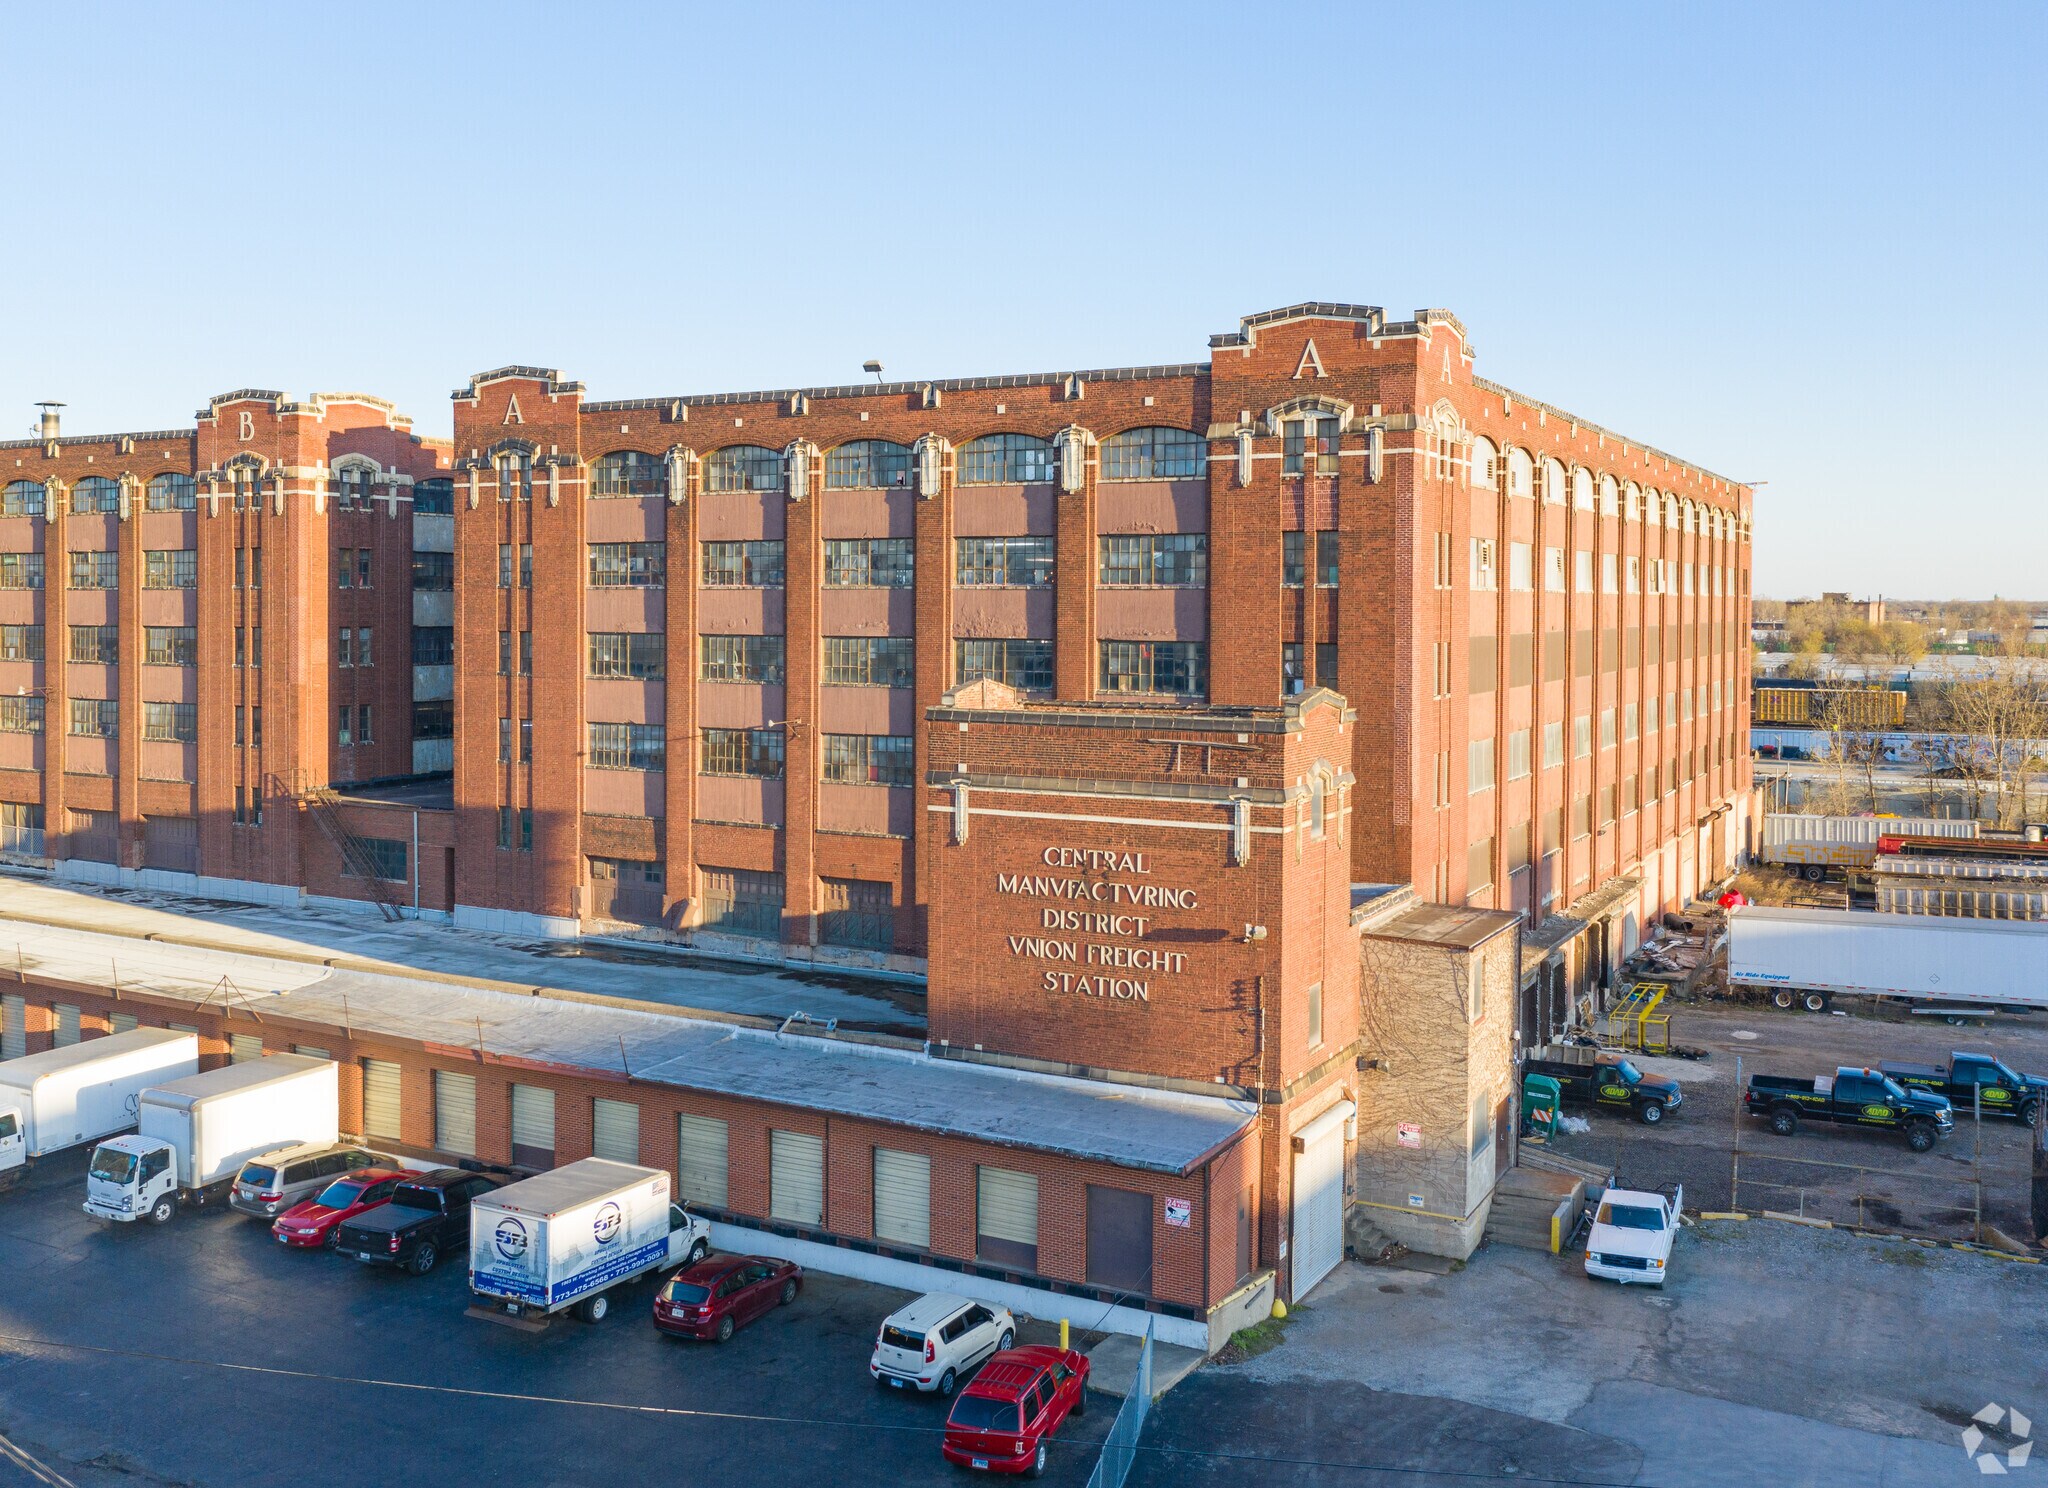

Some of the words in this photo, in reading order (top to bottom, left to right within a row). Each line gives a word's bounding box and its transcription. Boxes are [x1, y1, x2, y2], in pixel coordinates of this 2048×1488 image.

[1293, 338, 1328, 379] A
[1441, 345, 1452, 385] A
[503, 392, 525, 424] A
[238, 412, 255, 442] B
[1044, 847, 1150, 874] CENTRAL
[1043, 908, 1150, 937] DISTRICT
[1087, 944, 1187, 973] FREIGHT
[1043, 972, 1148, 1001] STATION
